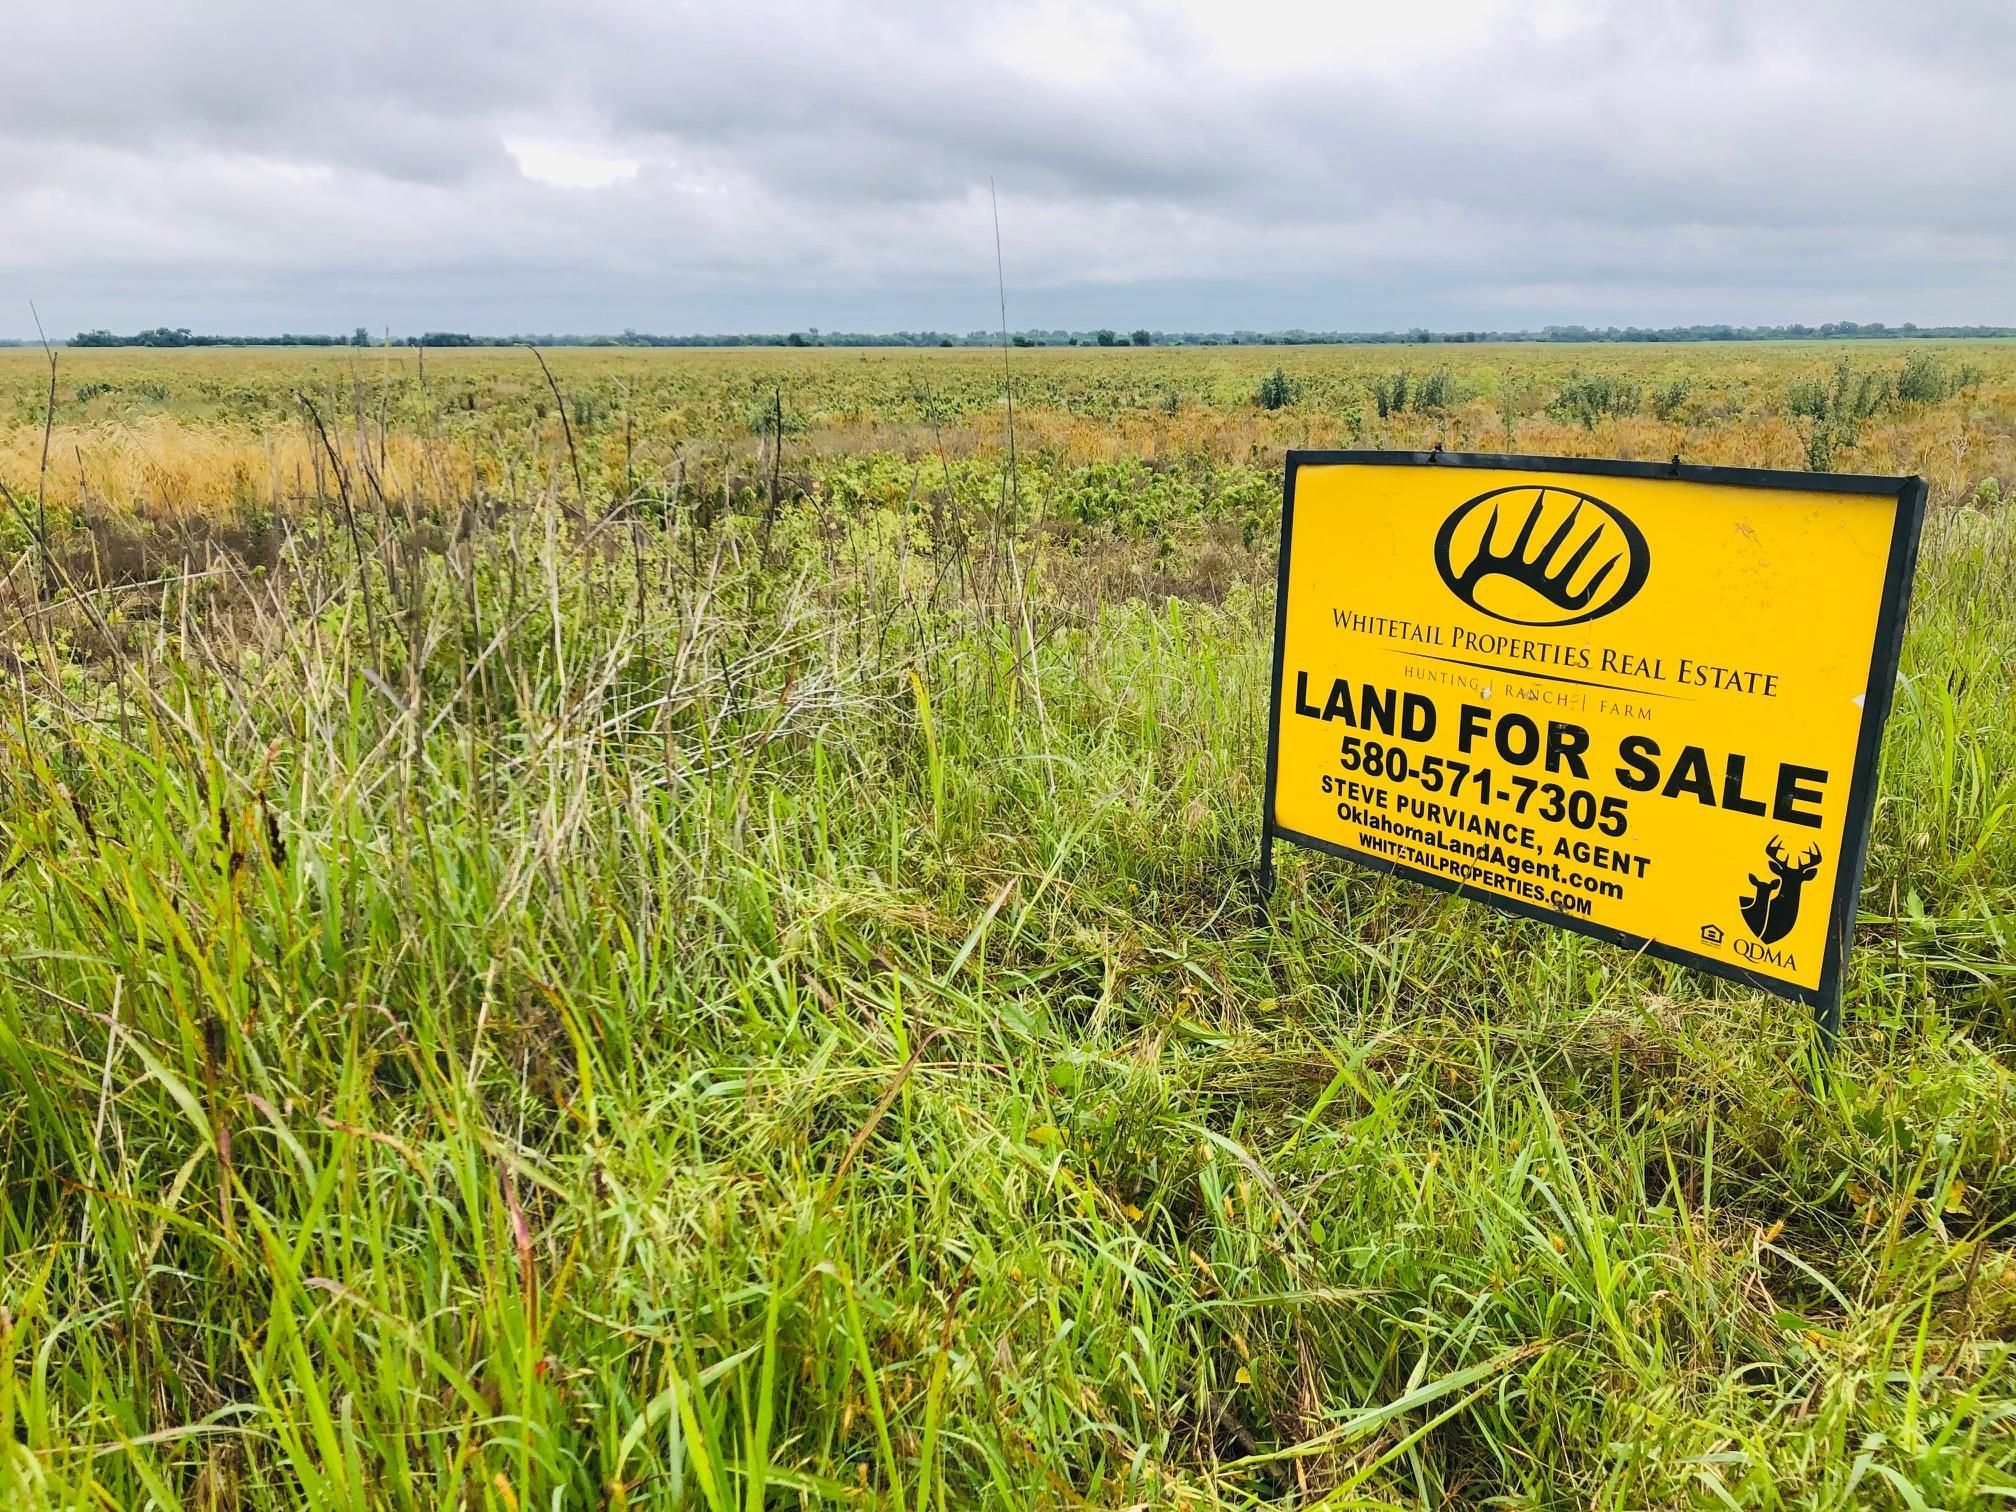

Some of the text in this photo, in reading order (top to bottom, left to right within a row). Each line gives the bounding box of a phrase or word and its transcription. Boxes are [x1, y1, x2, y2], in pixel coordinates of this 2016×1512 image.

[1333, 608, 1779, 697] WHITETAIL PROPERTIES REAL ESTATE
[1404, 665, 1652, 721] HUNTING RANCH FARM
[1295, 671, 1829, 829] LAND FOR SALE
[1340, 736, 1628, 837] 580-571-7305
[1321, 774, 1651, 878] STEVE PURVIANCE, AGENT
[1337, 803, 1624, 900] OklahomaLandAgent.com
[1359, 832, 1592, 915] WHITETAILPROPERTIES.COM
[1733, 938, 1797, 971] QDMA
